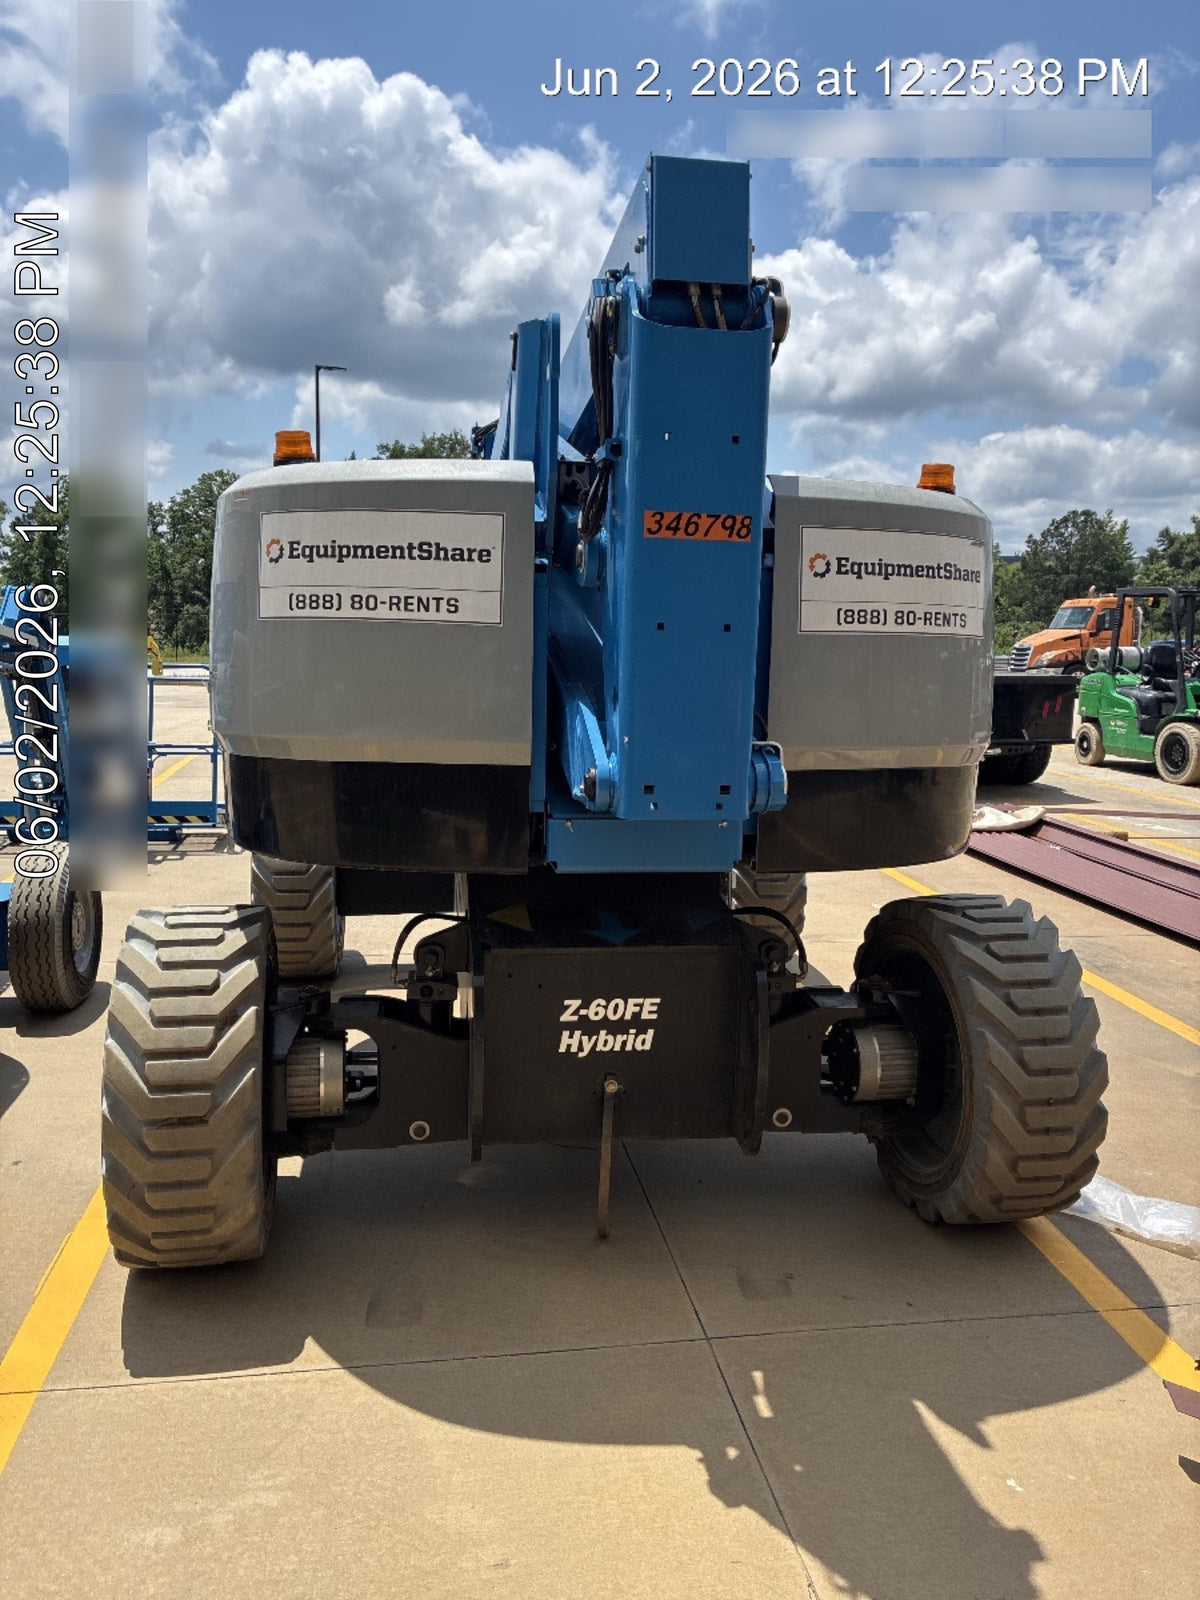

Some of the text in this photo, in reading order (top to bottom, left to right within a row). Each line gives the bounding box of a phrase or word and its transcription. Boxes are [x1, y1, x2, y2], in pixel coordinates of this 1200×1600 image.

[646, 511, 752, 539] 346798
[287, 539, 492, 563] EquipmentShare
[835, 556, 981, 583] EquipmentShare
[288, 593, 460, 614] (888) 80-RENTS
[836, 607, 967, 628] (888) 80-RENTS
[559, 998, 661, 1022] Z-60FE
[558, 1029, 655, 1058] Hybrid
